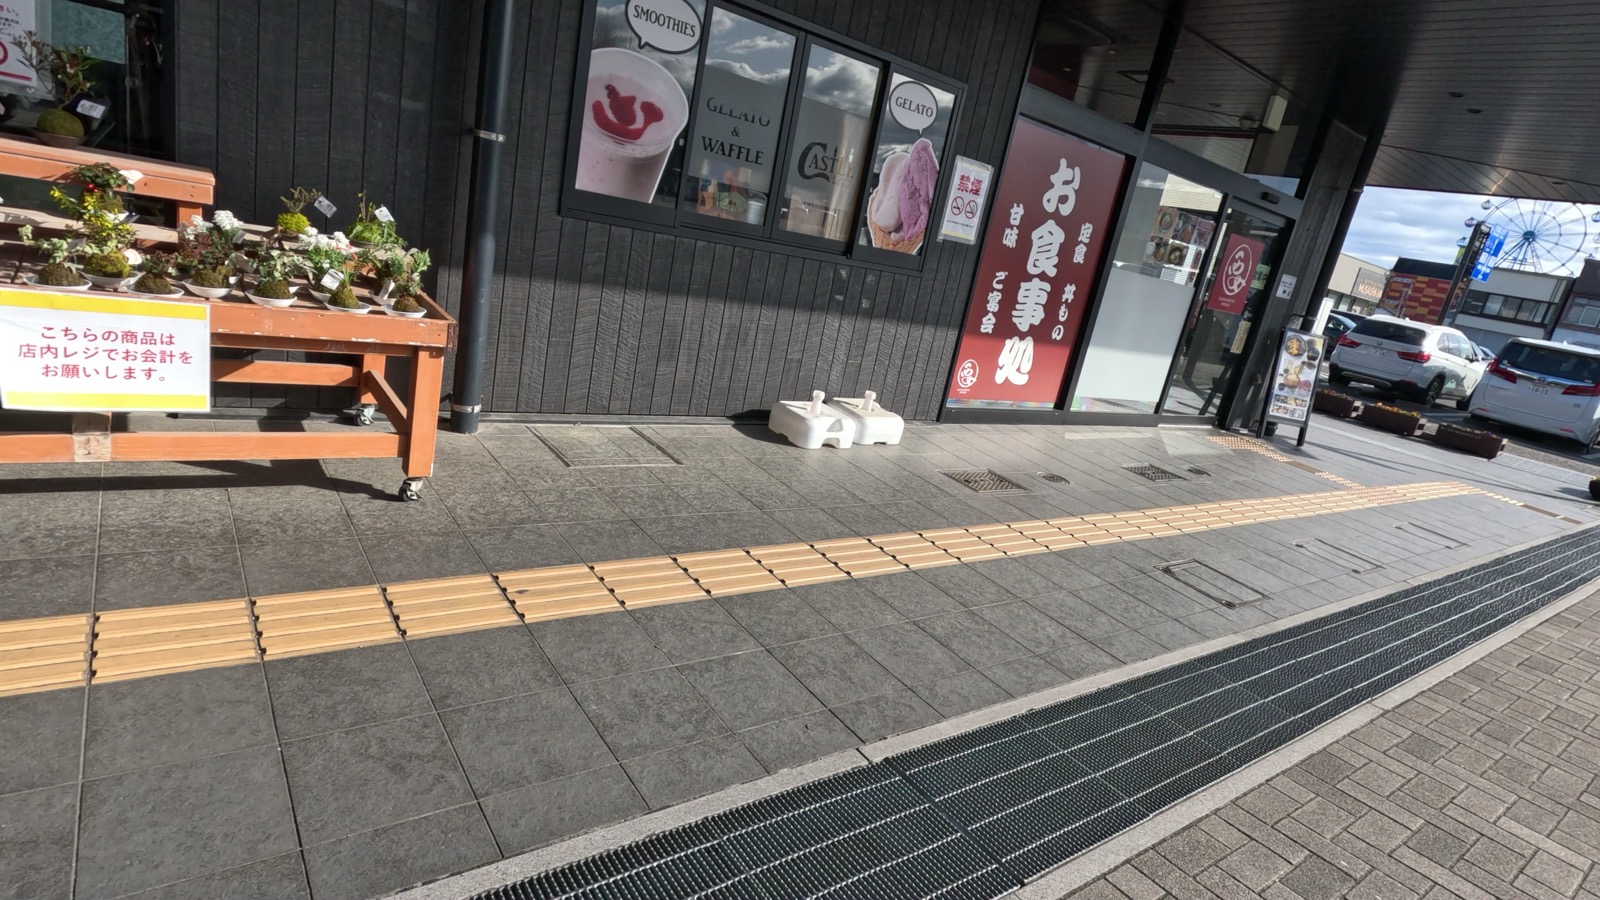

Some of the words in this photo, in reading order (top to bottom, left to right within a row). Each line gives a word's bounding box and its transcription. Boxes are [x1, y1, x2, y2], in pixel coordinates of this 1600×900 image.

[633, 4, 696, 38] SMOOTHIES
[895, 96, 934, 118] GELATO
[731, 126, 741, 138] &
[701, 136, 765, 166] WAFFLE
[957, 173, 984, 197] 禁煙
[1002, 202, 1025, 249] 甘味
[1073, 222, 1093, 264] 定食
[994, 158, 1081, 386] お食事処
[41, 326, 176, 346] こちらの商品は
[18, 343, 194, 365] 店内レジでお会計を
[41, 363, 166, 382] お願いします。
